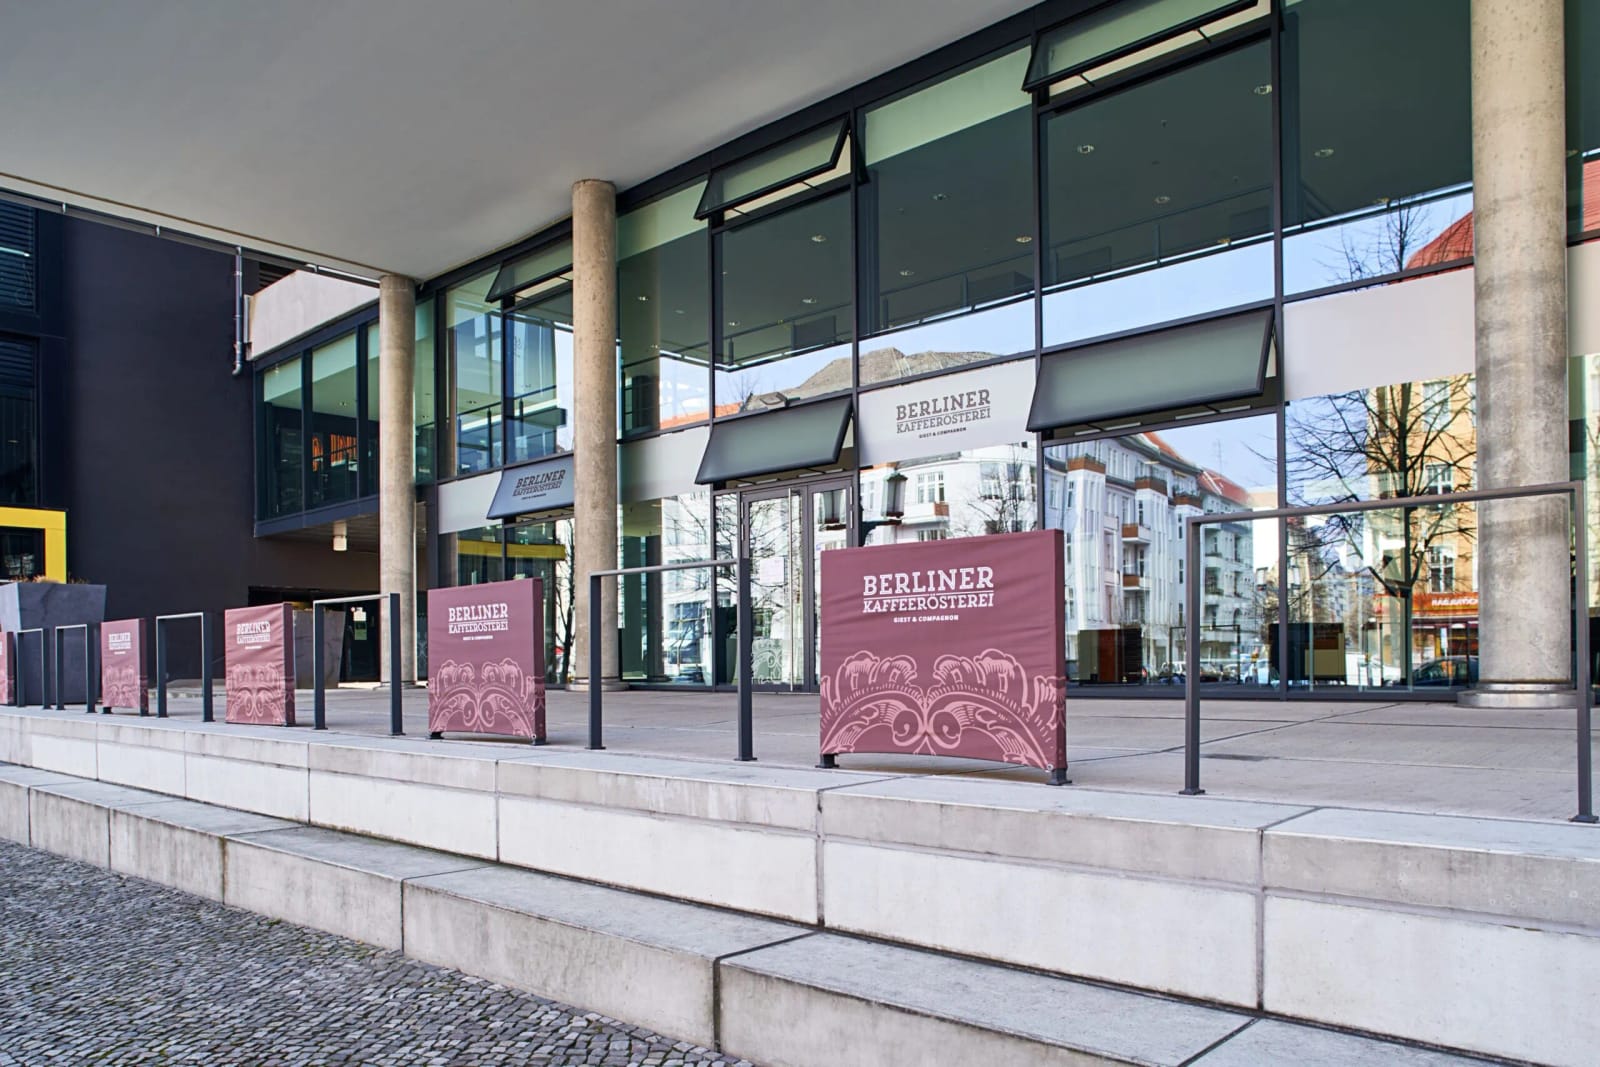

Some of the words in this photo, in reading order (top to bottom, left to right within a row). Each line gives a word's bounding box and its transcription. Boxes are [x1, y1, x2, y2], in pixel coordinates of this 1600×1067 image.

[896, 389, 991, 421] BERLINER
[516, 469, 566, 489] BERLINER
[863, 566, 994, 596] BERLINER
[448, 603, 508, 622] BERLINER
[863, 593, 994, 613] KAFFEERÖSTEREI
